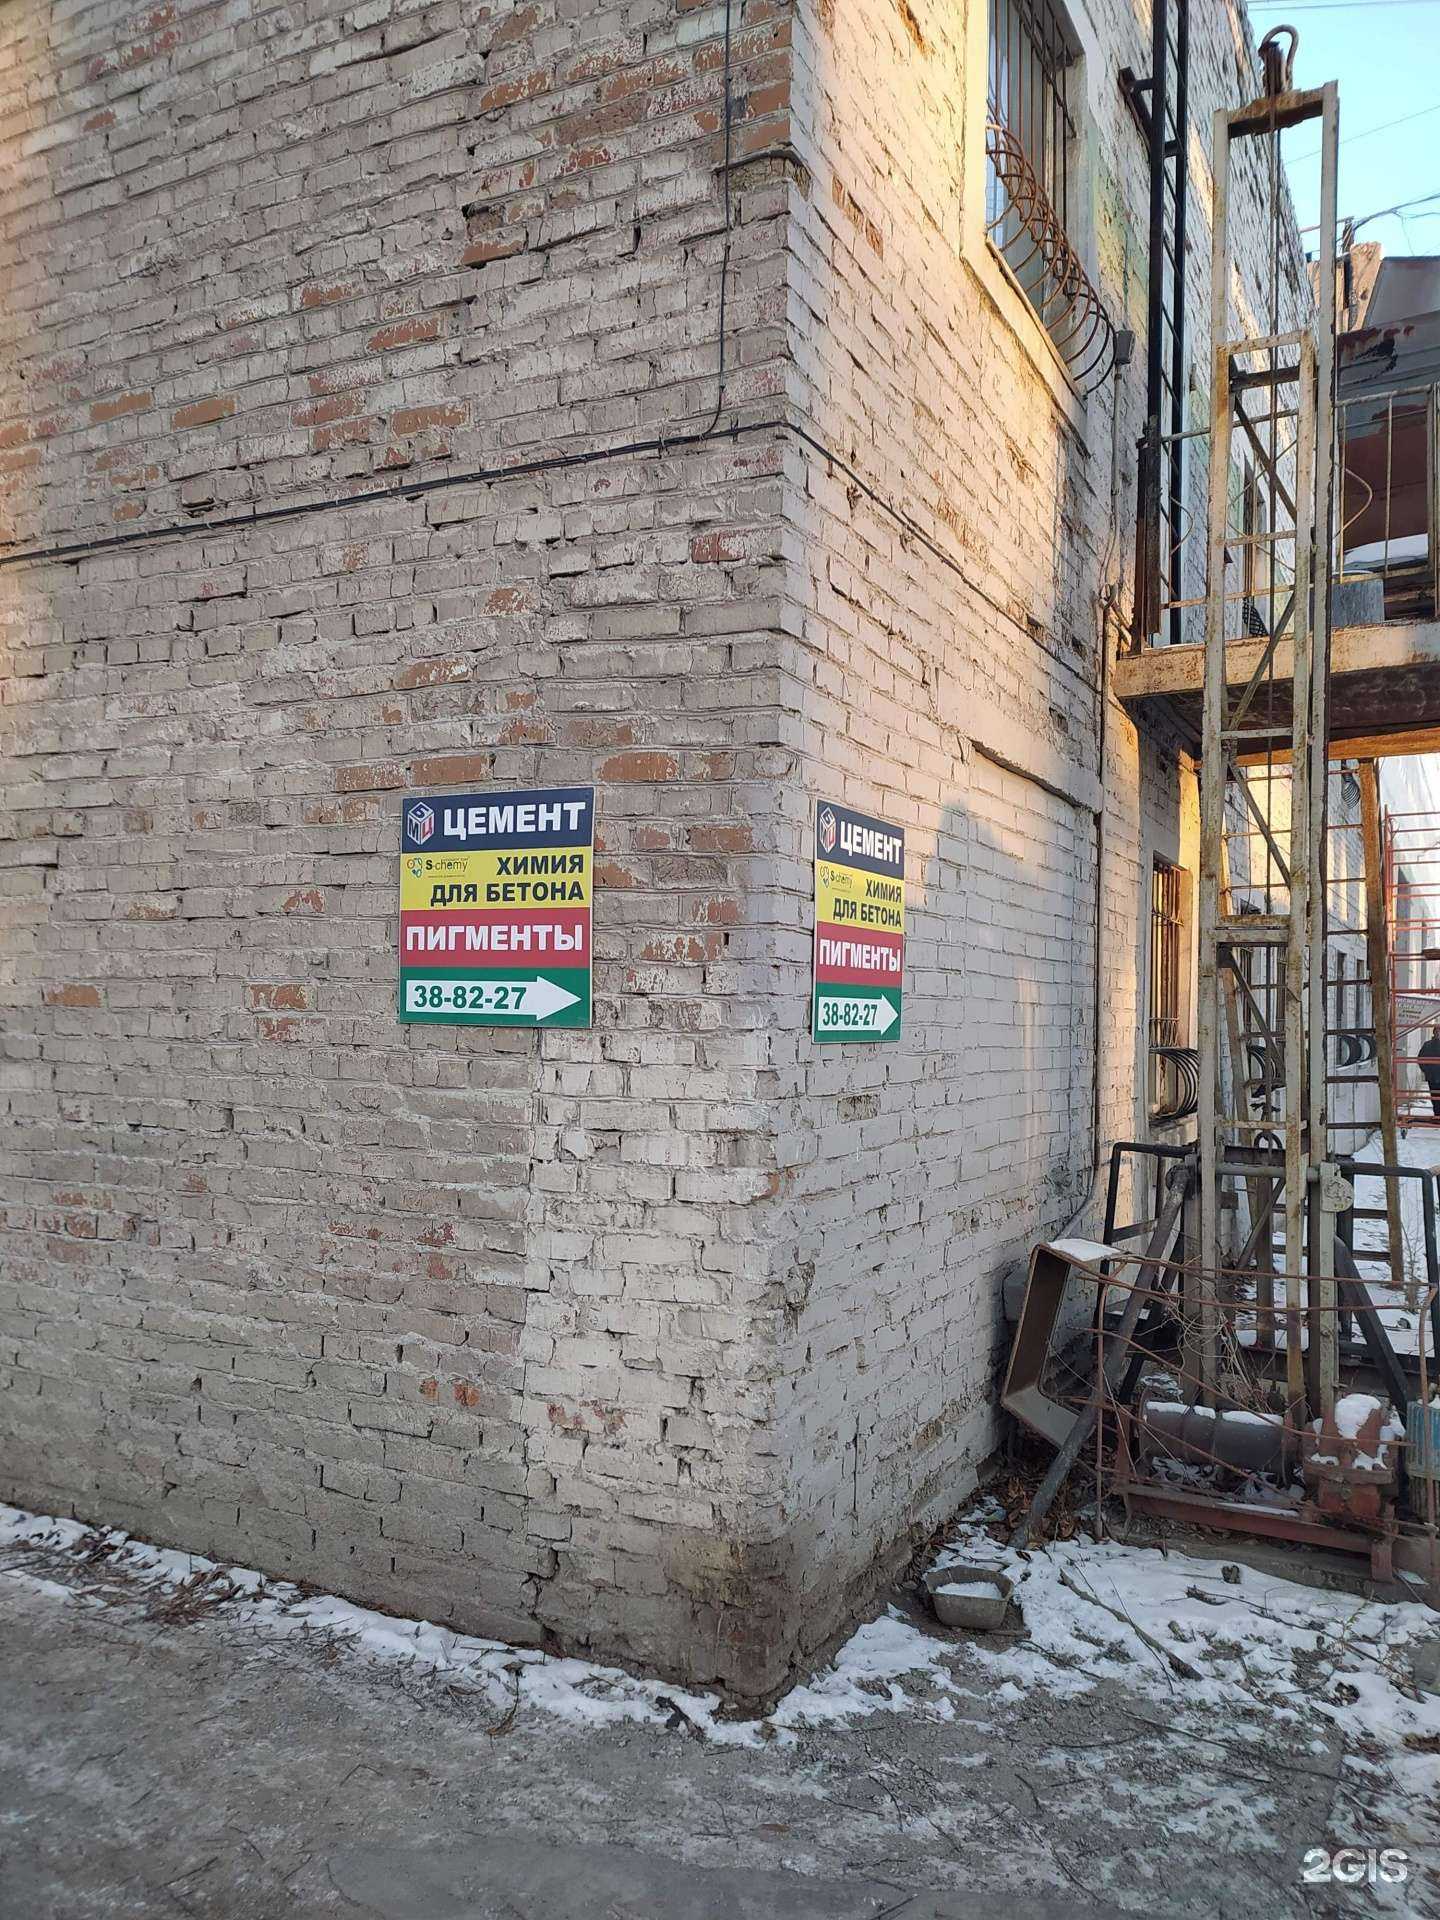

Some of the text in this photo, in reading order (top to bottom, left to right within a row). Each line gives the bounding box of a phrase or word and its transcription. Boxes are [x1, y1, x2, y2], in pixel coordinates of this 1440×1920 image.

[443, 801, 586, 841] ЦЕМЕНТ
[840, 820, 902, 864] ЦЕМЕНТ
[496, 854, 584, 876] ХИМИЯ
[430, 881, 585, 907] ДЛЯ БЕТОНА
[865, 878, 902, 904] ХИМИЯ
[833, 897, 902, 928] ДЛЯ БЕТОНА
[406, 924, 583, 951] ПИГМЕНТЫ
[820, 938, 901, 972] ПИГМЕНТЫ
[414, 985, 527, 1010] 38-82-27
[822, 1002, 878, 1026] 38-82-27
